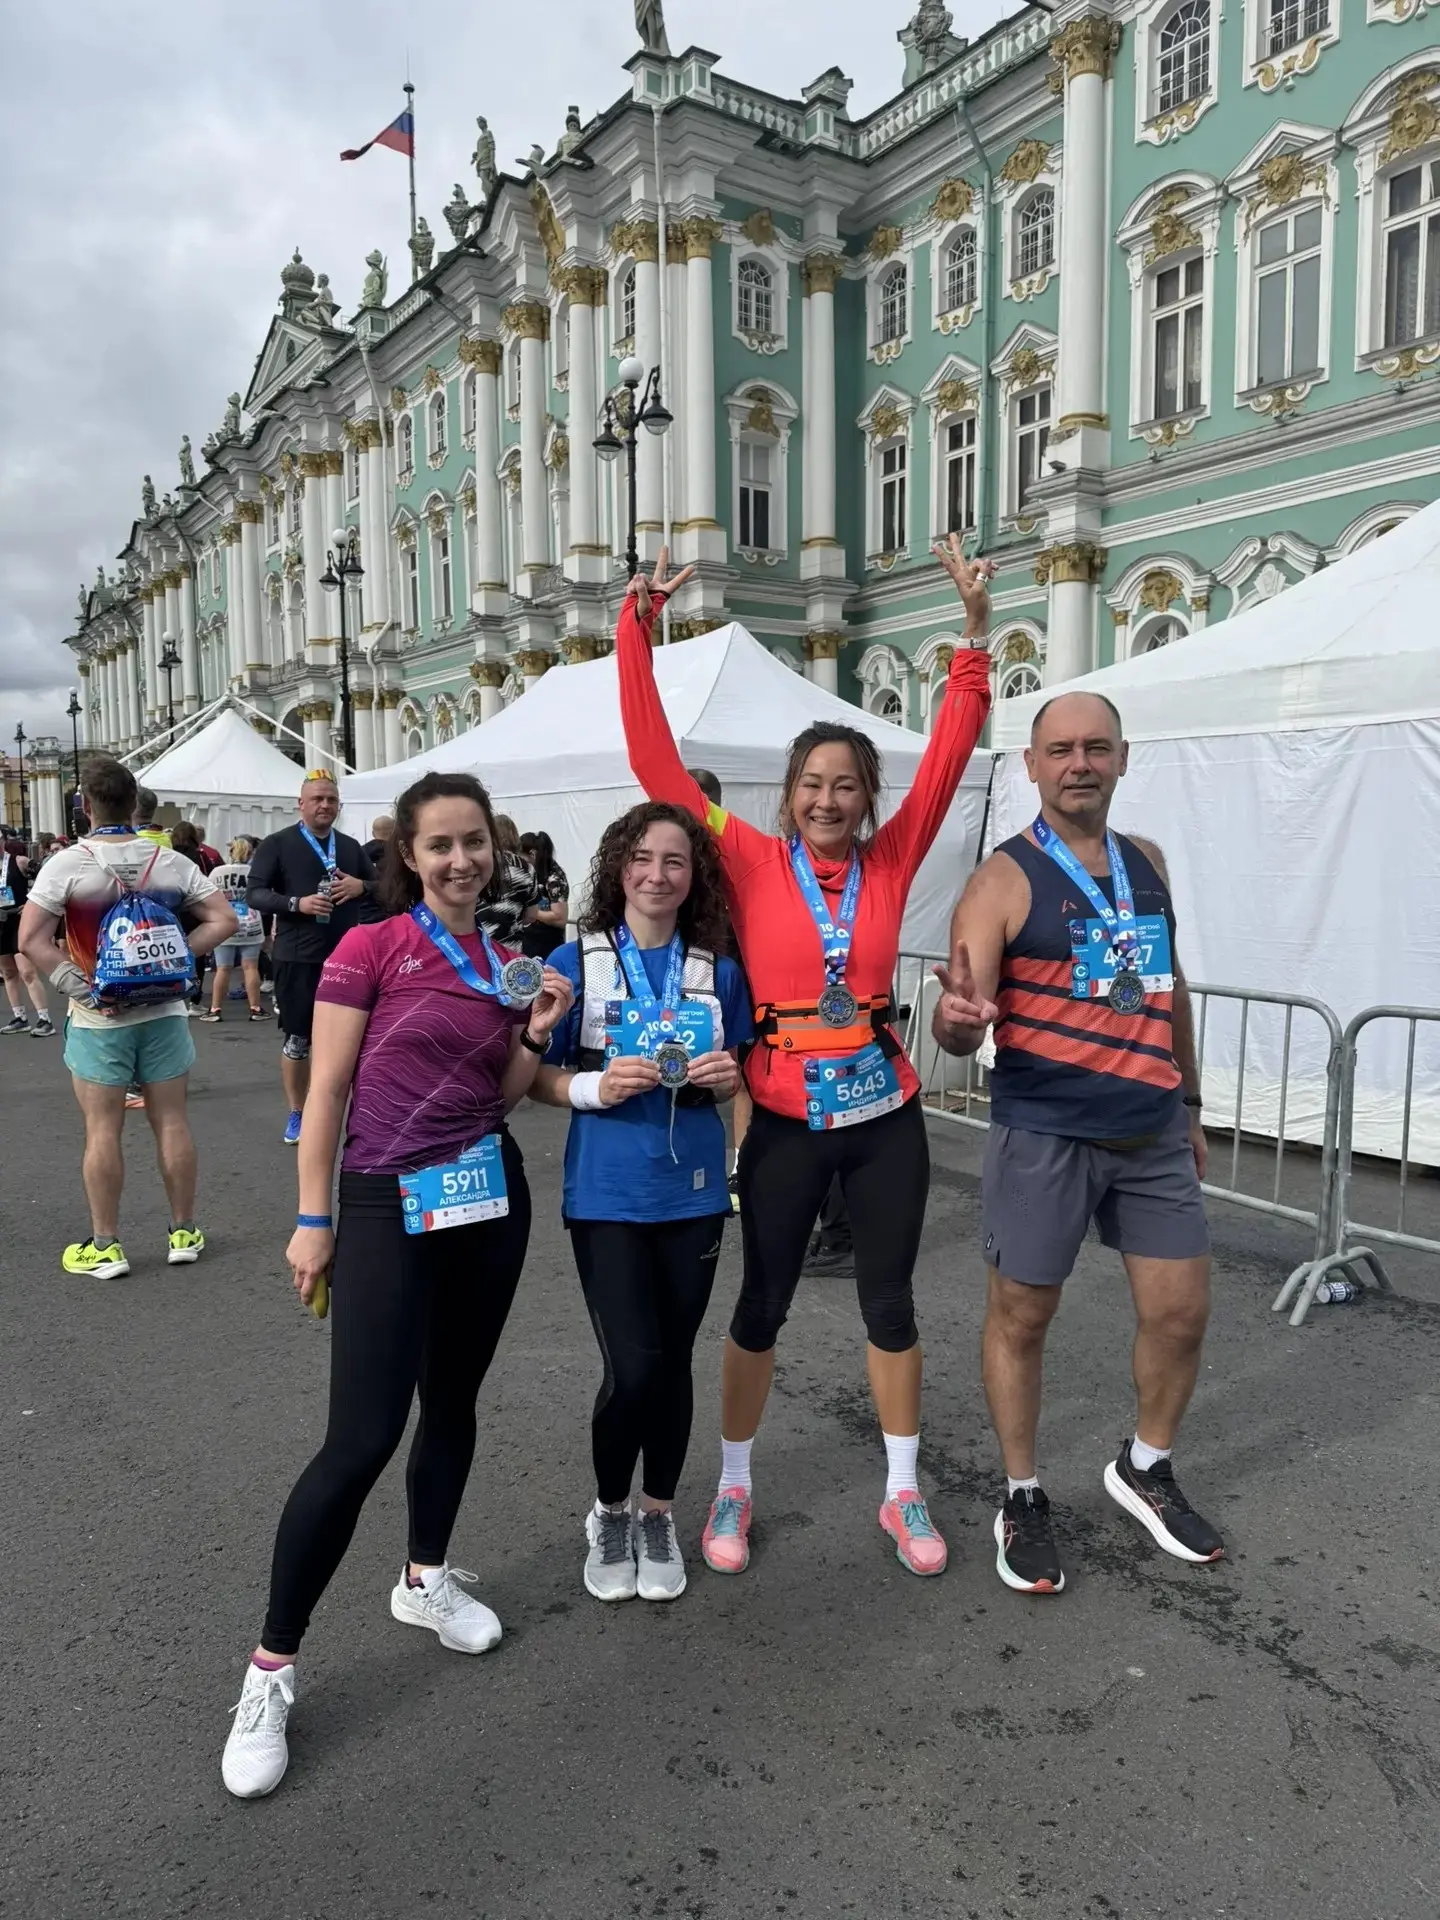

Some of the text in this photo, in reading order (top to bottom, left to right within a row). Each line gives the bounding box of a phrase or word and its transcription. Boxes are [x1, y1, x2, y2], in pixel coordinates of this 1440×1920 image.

[1100, 908, 1113, 918] 10
[820, 923, 834, 932] 10
[105, 950, 125, 958] ПЕТ
[137, 942, 176, 960] 5016
[1104, 945, 1153, 967] 427
[646, 1021, 659, 1032] 10
[636, 1030, 695, 1050] 42
[609, 1047, 619, 1057] D
[837, 1070, 886, 1102] 5643
[811, 1102, 820, 1111] D
[848, 1093, 878, 1108] ИНДИРА
[443, 1167, 488, 1195] 5911
[440, 1190, 491, 1206] АЛЕКСАНДРА
[406, 1199, 417, 1211] D
